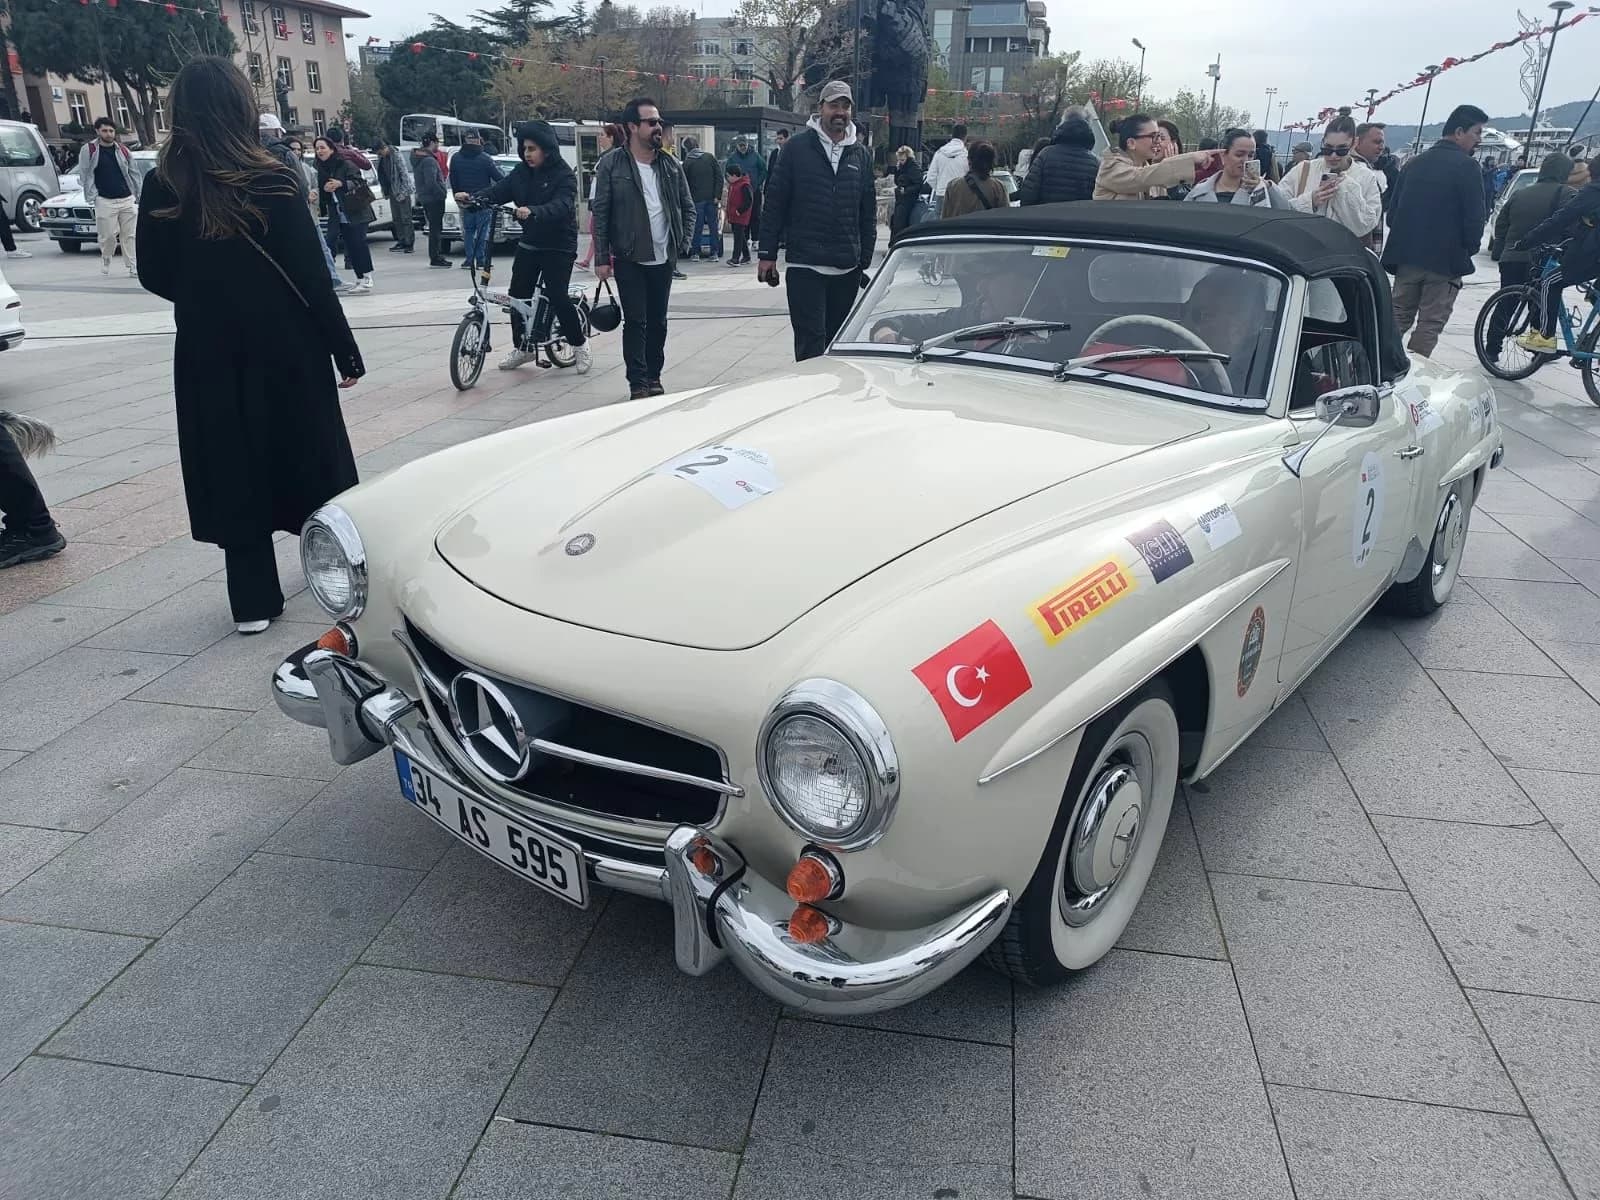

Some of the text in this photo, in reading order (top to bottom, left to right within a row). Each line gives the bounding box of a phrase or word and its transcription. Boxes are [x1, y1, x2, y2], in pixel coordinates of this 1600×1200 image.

[675, 454, 728, 475] 2
[1362, 487, 1375, 545] 2
[1037, 561, 1128, 637] PIRELLI
[411, 766, 568, 890] 34 AS 595
